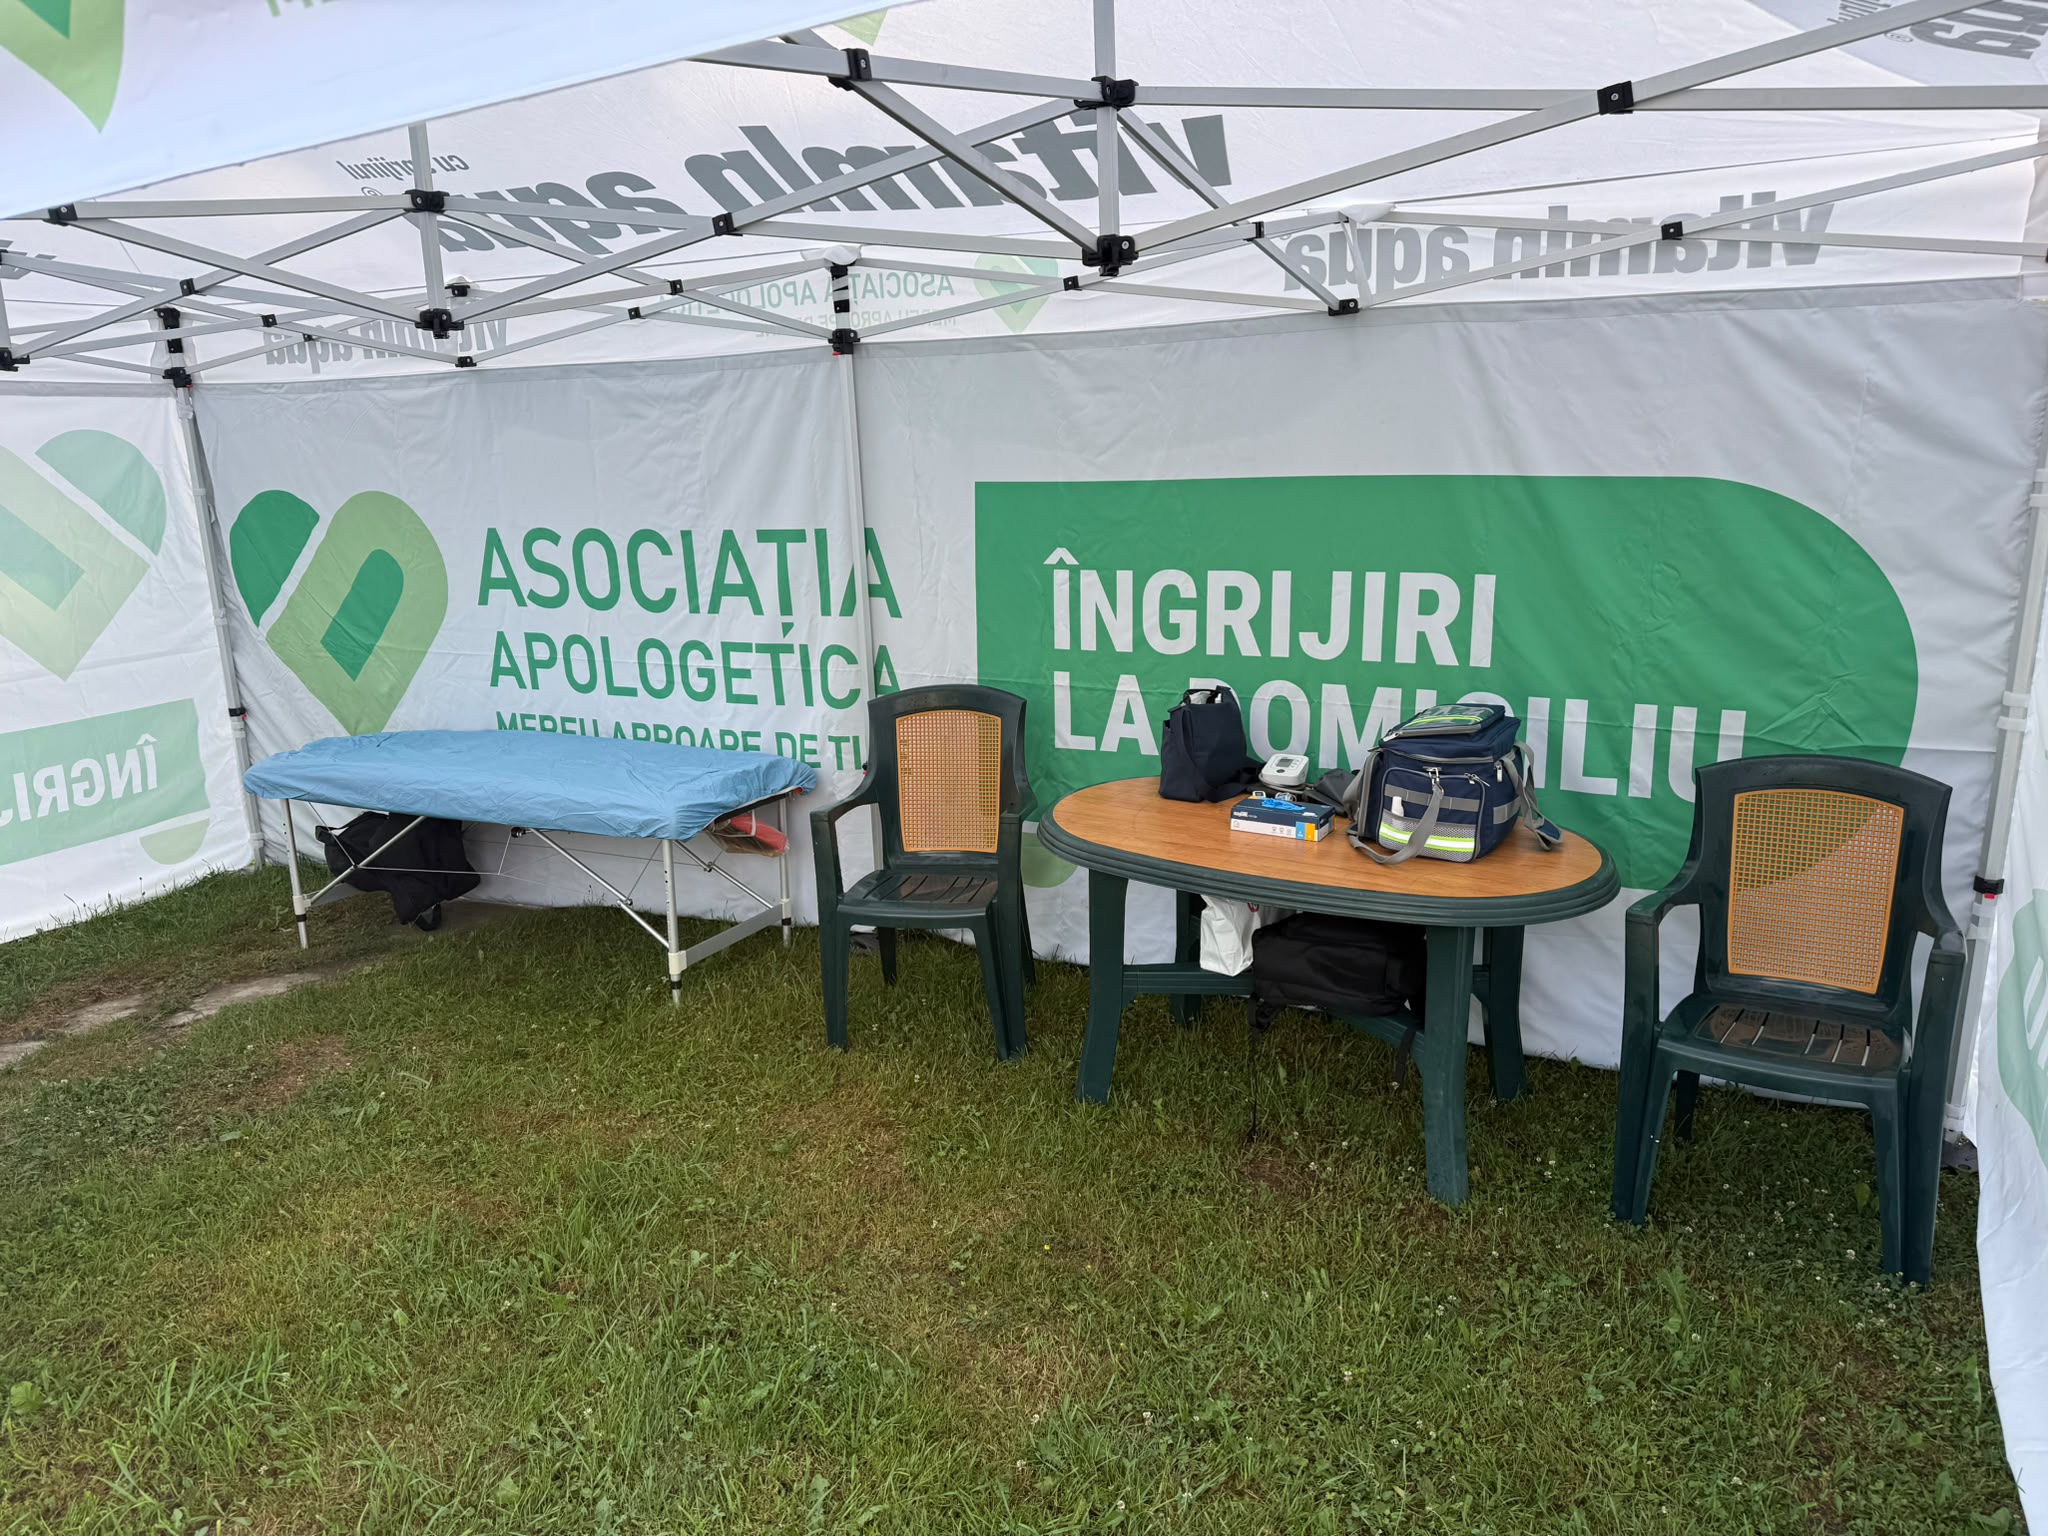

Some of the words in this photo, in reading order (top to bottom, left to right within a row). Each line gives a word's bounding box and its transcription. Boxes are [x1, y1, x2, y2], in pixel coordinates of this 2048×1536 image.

[1043, 547, 1497, 668] ÎNGRIJIRI
[490, 630, 903, 710] APOLOGETICA
[775, 732, 822, 769] DE
[828, 735, 863, 771] TI
[1053, 671, 1159, 756] LA
[1189, 677, 1747, 803] OMILIU
